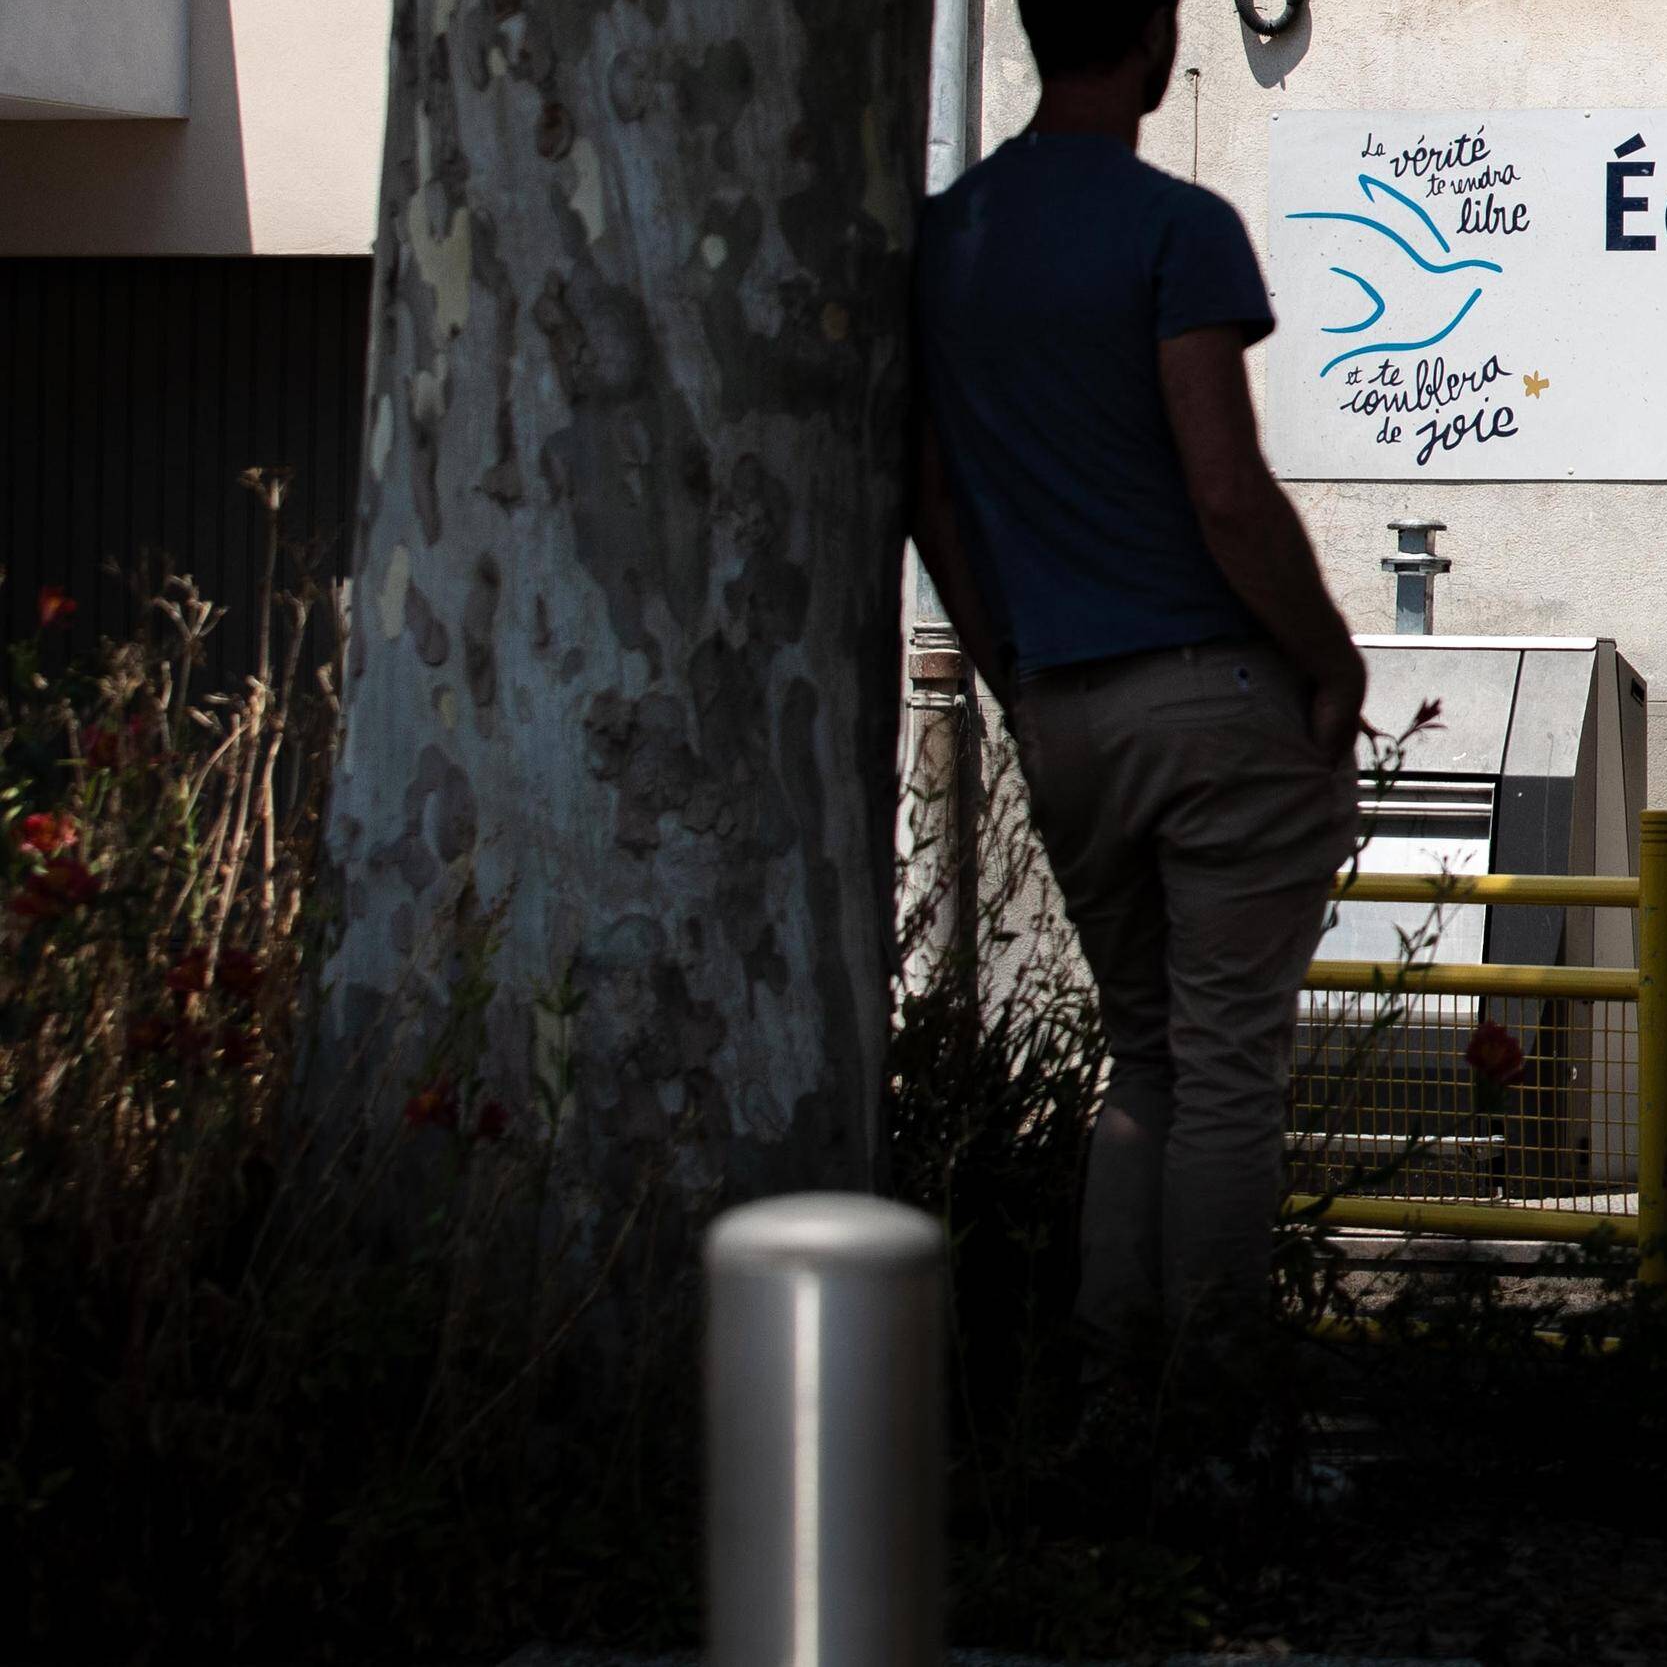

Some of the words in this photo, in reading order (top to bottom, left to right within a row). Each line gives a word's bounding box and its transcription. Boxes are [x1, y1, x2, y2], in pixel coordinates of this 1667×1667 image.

[1362, 133, 1385, 158] La
[1389, 125, 1491, 178] vérité
[1425, 173, 1447, 198] te
[1449, 163, 1521, 194] rendra
[1455, 192, 1530, 234] libre
[1340, 355, 1512, 416] comblera
[1346, 366, 1362, 385] et
[1368, 358, 1404, 388] te
[1377, 417, 1401, 444] de
[1415, 396, 1519, 467] joie
